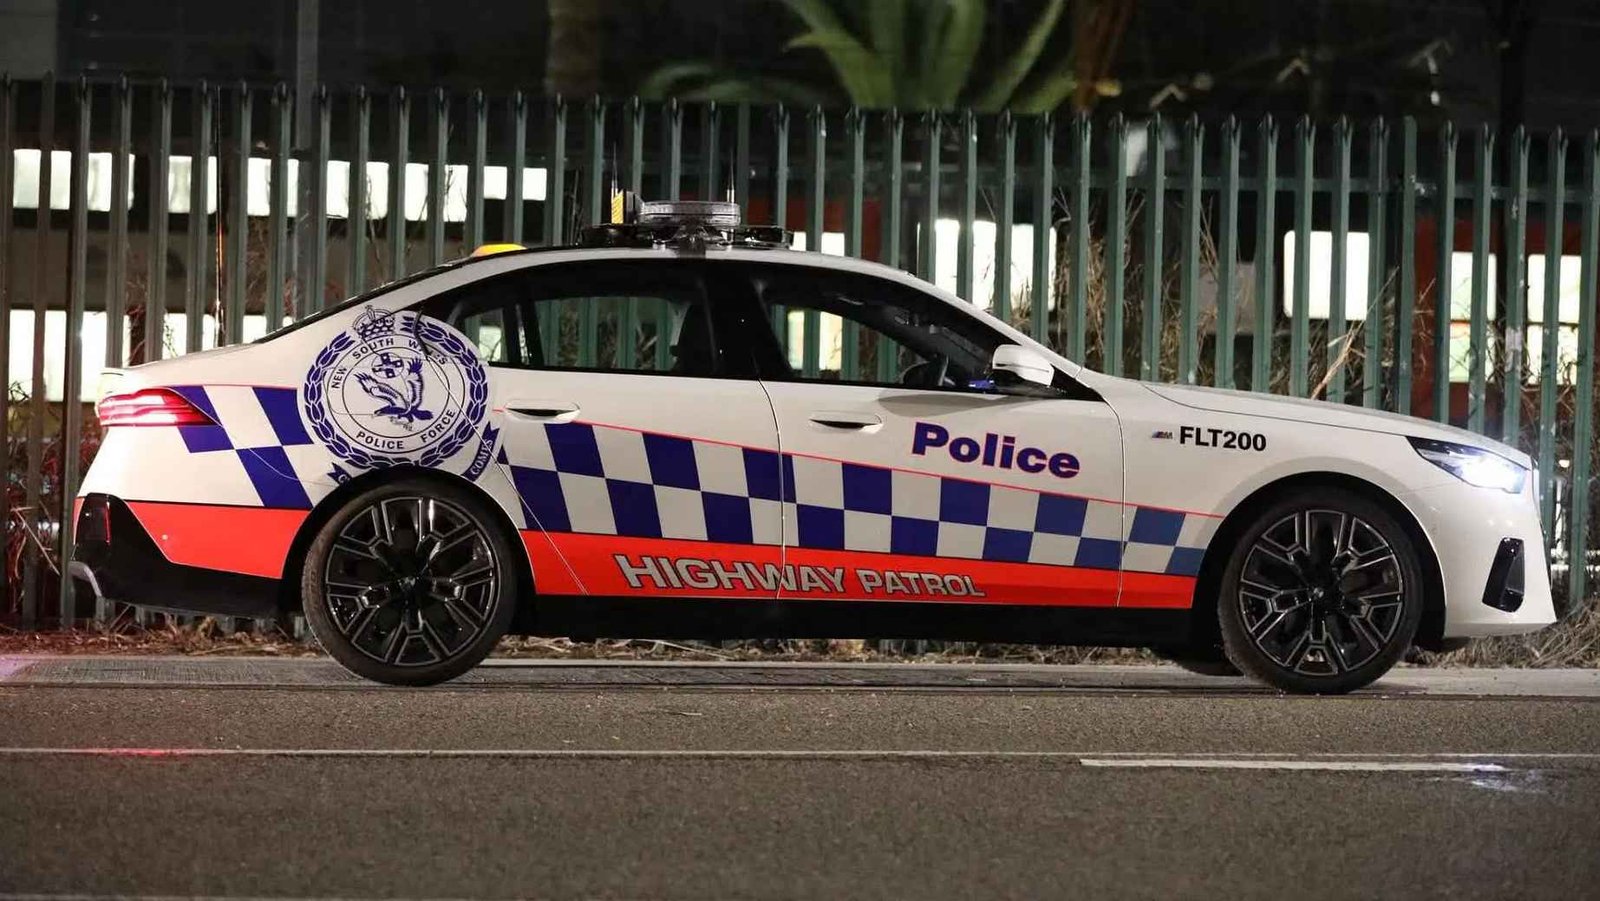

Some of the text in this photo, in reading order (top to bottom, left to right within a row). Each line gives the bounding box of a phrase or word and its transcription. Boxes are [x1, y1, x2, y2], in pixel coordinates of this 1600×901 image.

[331, 367, 347, 389] NEW
[352, 337, 394, 360] SOUTH
[356, 409, 456, 450] POLICE FORCE
[911, 421, 1080, 479] Police
[1179, 425, 1267, 452] FLT200
[613, 553, 987, 597] HIGHWAY PATROL
